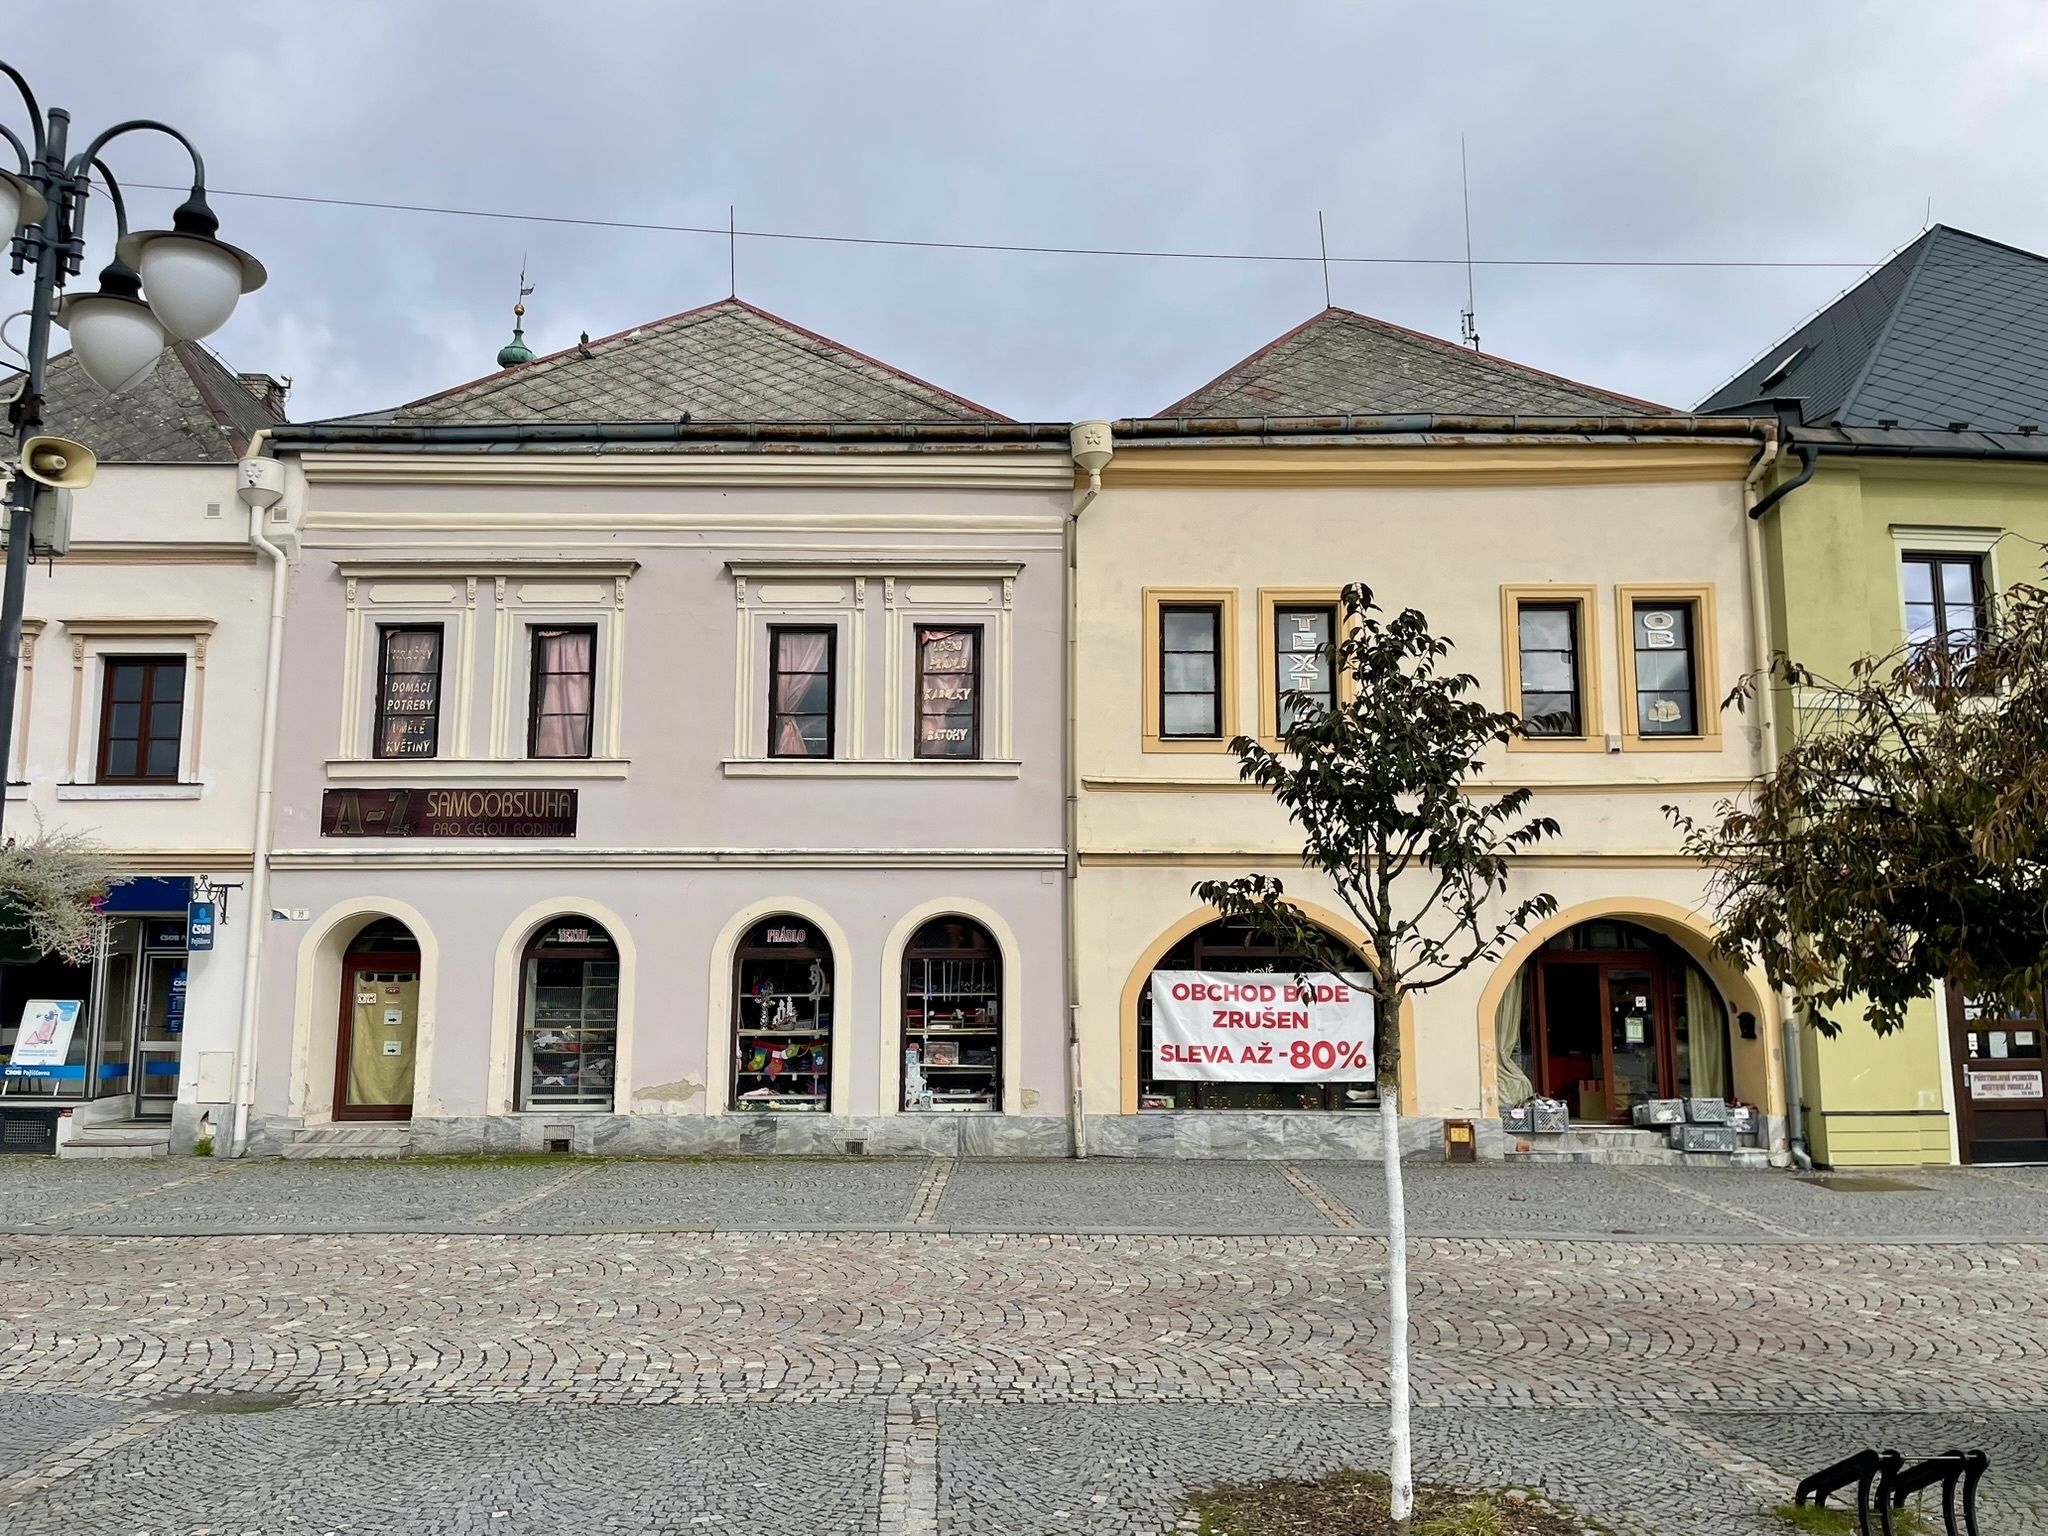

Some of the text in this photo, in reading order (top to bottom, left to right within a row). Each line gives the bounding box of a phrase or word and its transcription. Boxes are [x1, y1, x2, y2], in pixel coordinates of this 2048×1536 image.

[391, 680, 432, 693] DOMÁCÍ
[386, 696, 434, 711] POTŘEBY
[385, 738, 431, 753] KVĚTINY
[426, 791, 571, 818] SAMOOBSLUHA
[432, 822, 461, 836] PRO
[466, 822, 507, 836] CELOU
[192, 923, 211, 934] ČSOB
[766, 925, 806, 943] PRÁDLO
[1171, 983, 1276, 1002] OBCHOD
[1212, 1007, 1309, 1029] ZRUŠEN
[1160, 1044, 1234, 1063] SLEVA
[1240, 1042, 1273, 1064] AŽ
